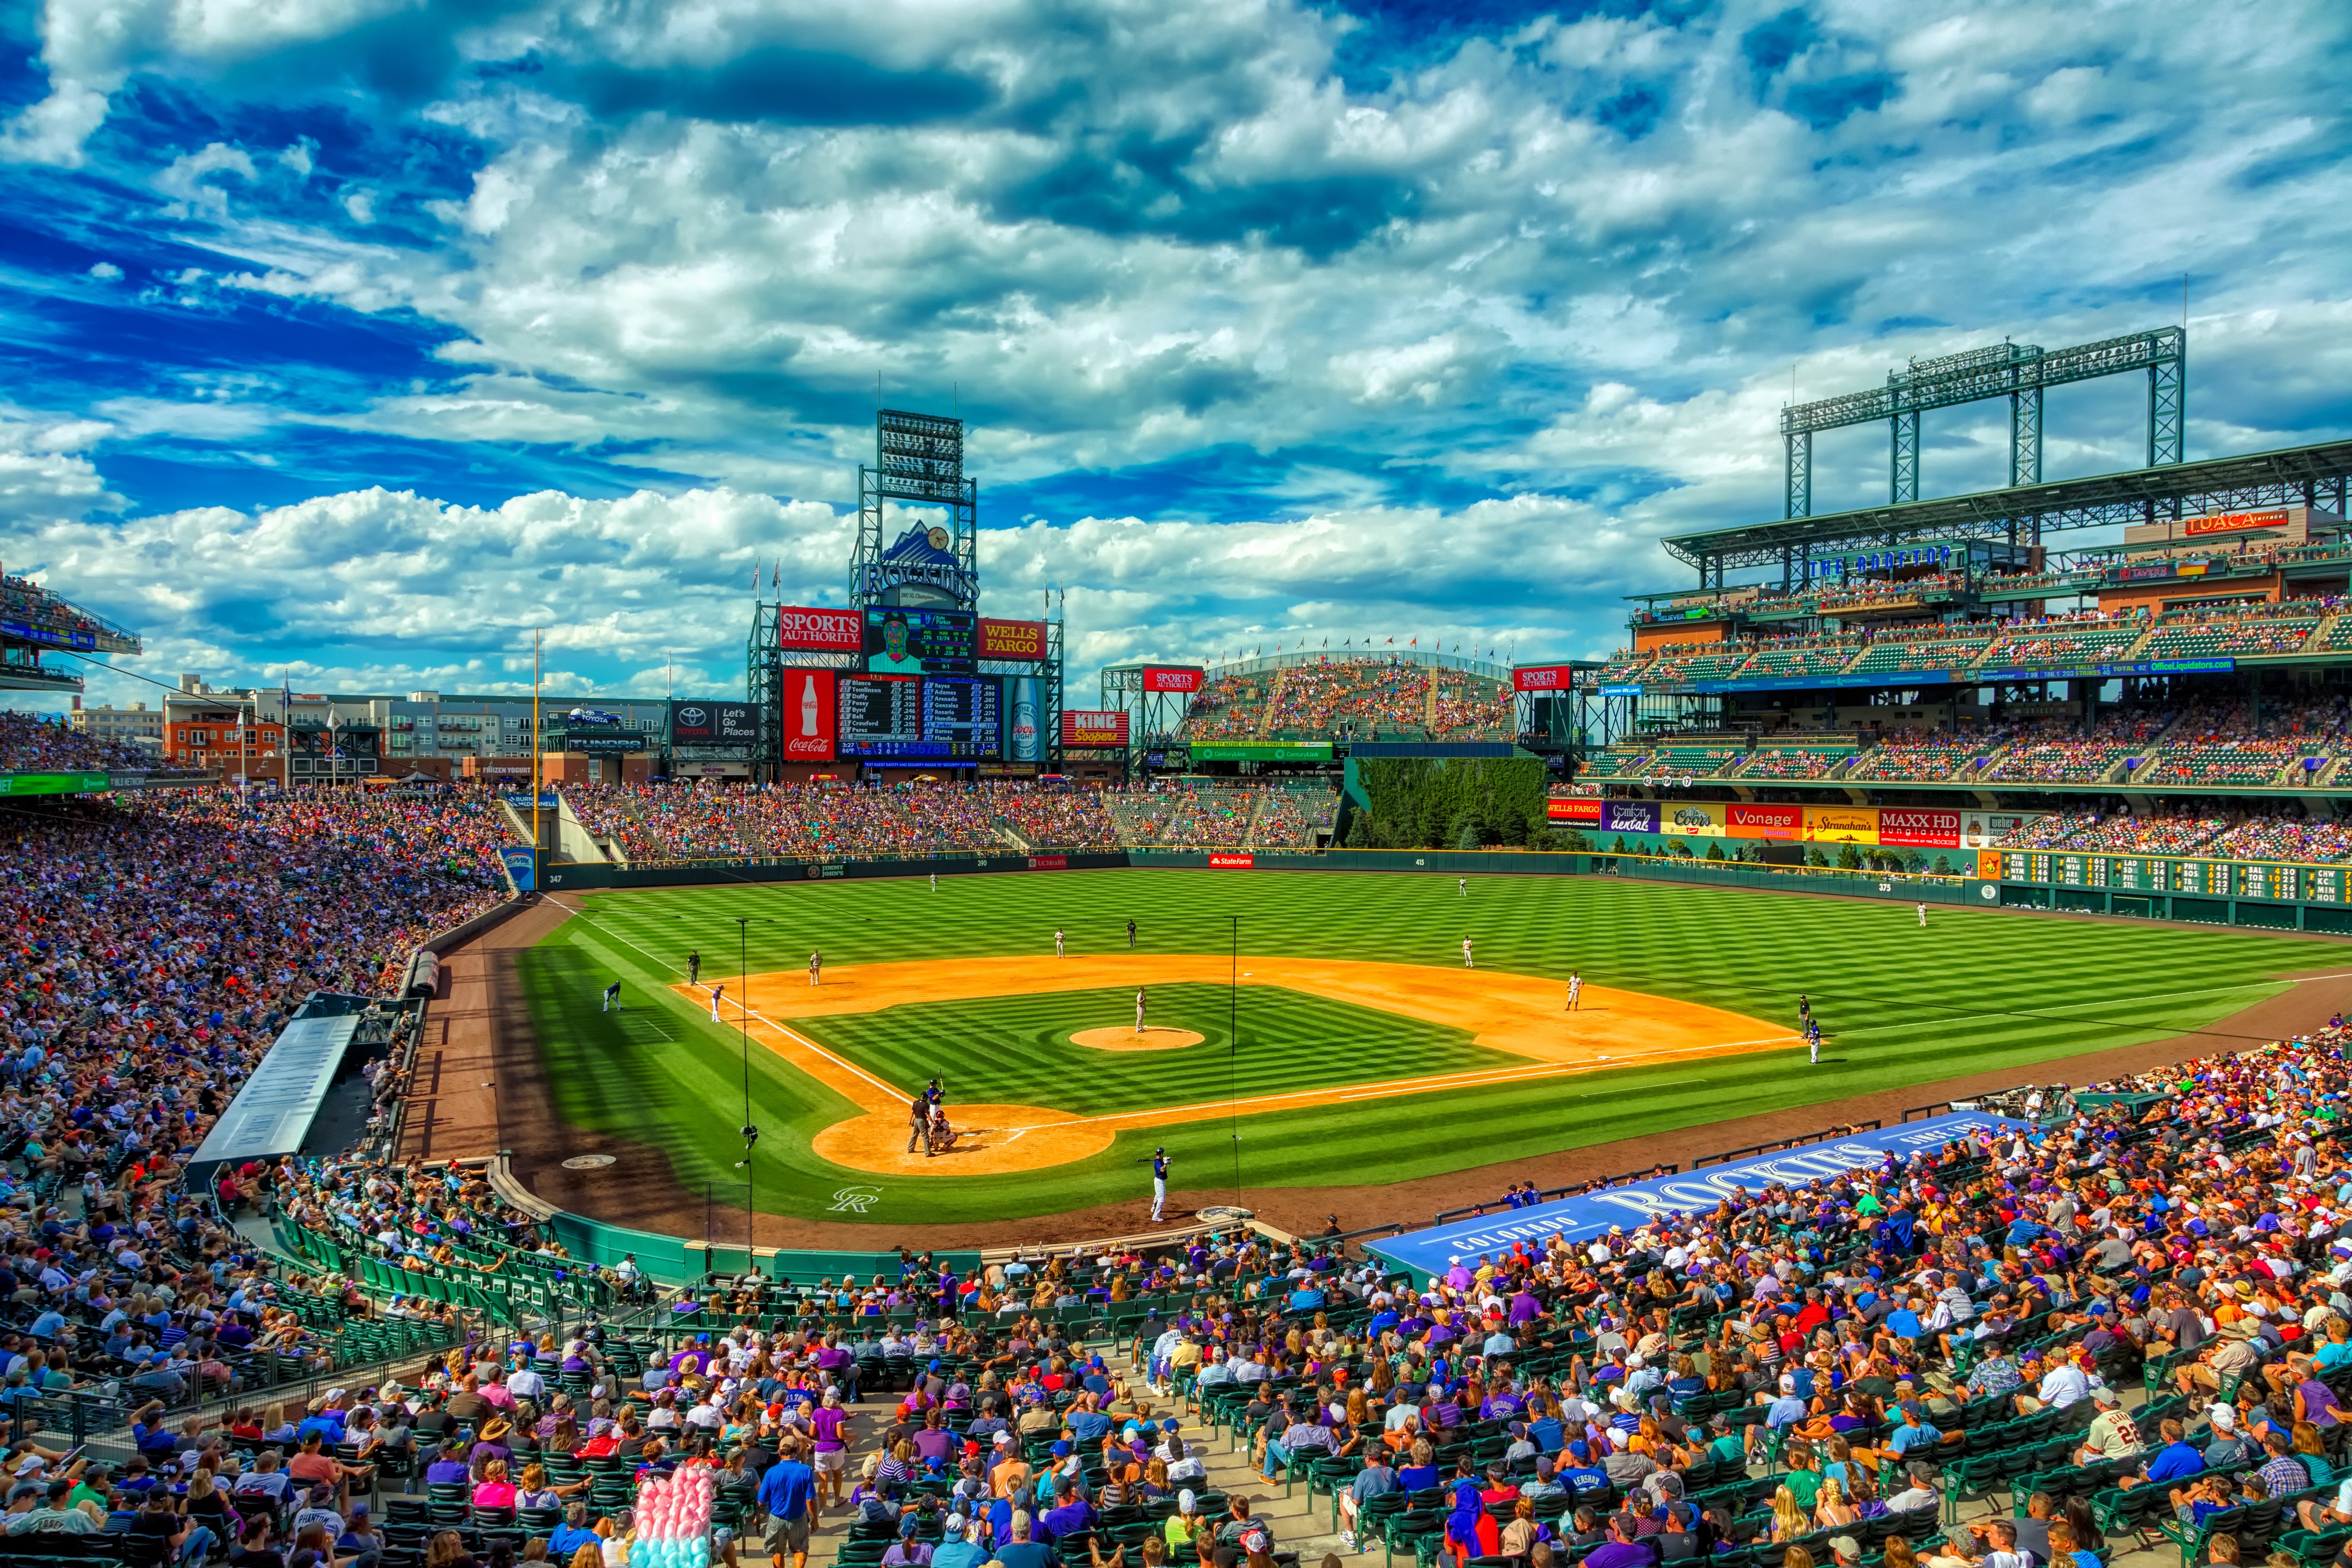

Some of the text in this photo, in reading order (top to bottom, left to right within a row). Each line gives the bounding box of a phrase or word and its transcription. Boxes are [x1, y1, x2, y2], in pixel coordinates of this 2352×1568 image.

[2186, 512, 2256, 531] TUACA
[1809, 546, 1951, 577] THE ROOFTOP
[2132, 567, 2168, 577] TAVERN
[858, 563, 981, 601] ROCKIES
[783, 613, 859, 633] SPORTS
[783, 630, 859, 643] AUTHORITY
[985, 625, 1037, 639] WELLS
[986, 639, 1037, 653] FARGO
[2151, 658, 2231, 672] OfficeLiquidators.com
[1156, 673, 1192, 683] SPORTS
[1522, 671, 1557, 681] SPORTS
[723, 708, 745, 717] Let's
[582, 715, 608, 724] TOYOTA
[723, 718, 736, 727] Go
[1075, 714, 1117, 729] KING
[723, 727, 755, 736] Places
[1013, 723, 1037, 734] Coors
[1074, 728, 1118, 744] Soopers
[571, 739, 642, 748] TUNDRA
[789, 738, 830, 753] Coca-Cola
[125, 777, 146, 785] NETWORK
[1613, 803, 1646, 817] Comfort
[1611, 814, 1649, 831] dental
[1674, 810, 1712, 827] Coors
[1735, 810, 1792, 827] Vonage
[1817, 815, 1872, 832] Stranahan's
[1882, 813, 1957, 828] MAXX HD
[1991, 817, 2014, 828] weber
[1765, 828, 1791, 837] Business
[1882, 827, 1957, 837] sunglasses
[1879, 883, 1891, 891] 375
[1451, 1122, 1992, 1251] COLORADO ROCKIES SINCE 1993
[1881, 1228, 1891, 1241] 28
[1489, 1399, 1515, 1412] ARENADO
[2108, 1413, 2130, 1425] CLARK
[2116, 1422, 2141, 1446] 22
[1573, 1474, 1601, 1486] KERSHAW
[38, 1519, 65, 1530] POSEY
[298, 1514, 330, 1524] PHANTOM
